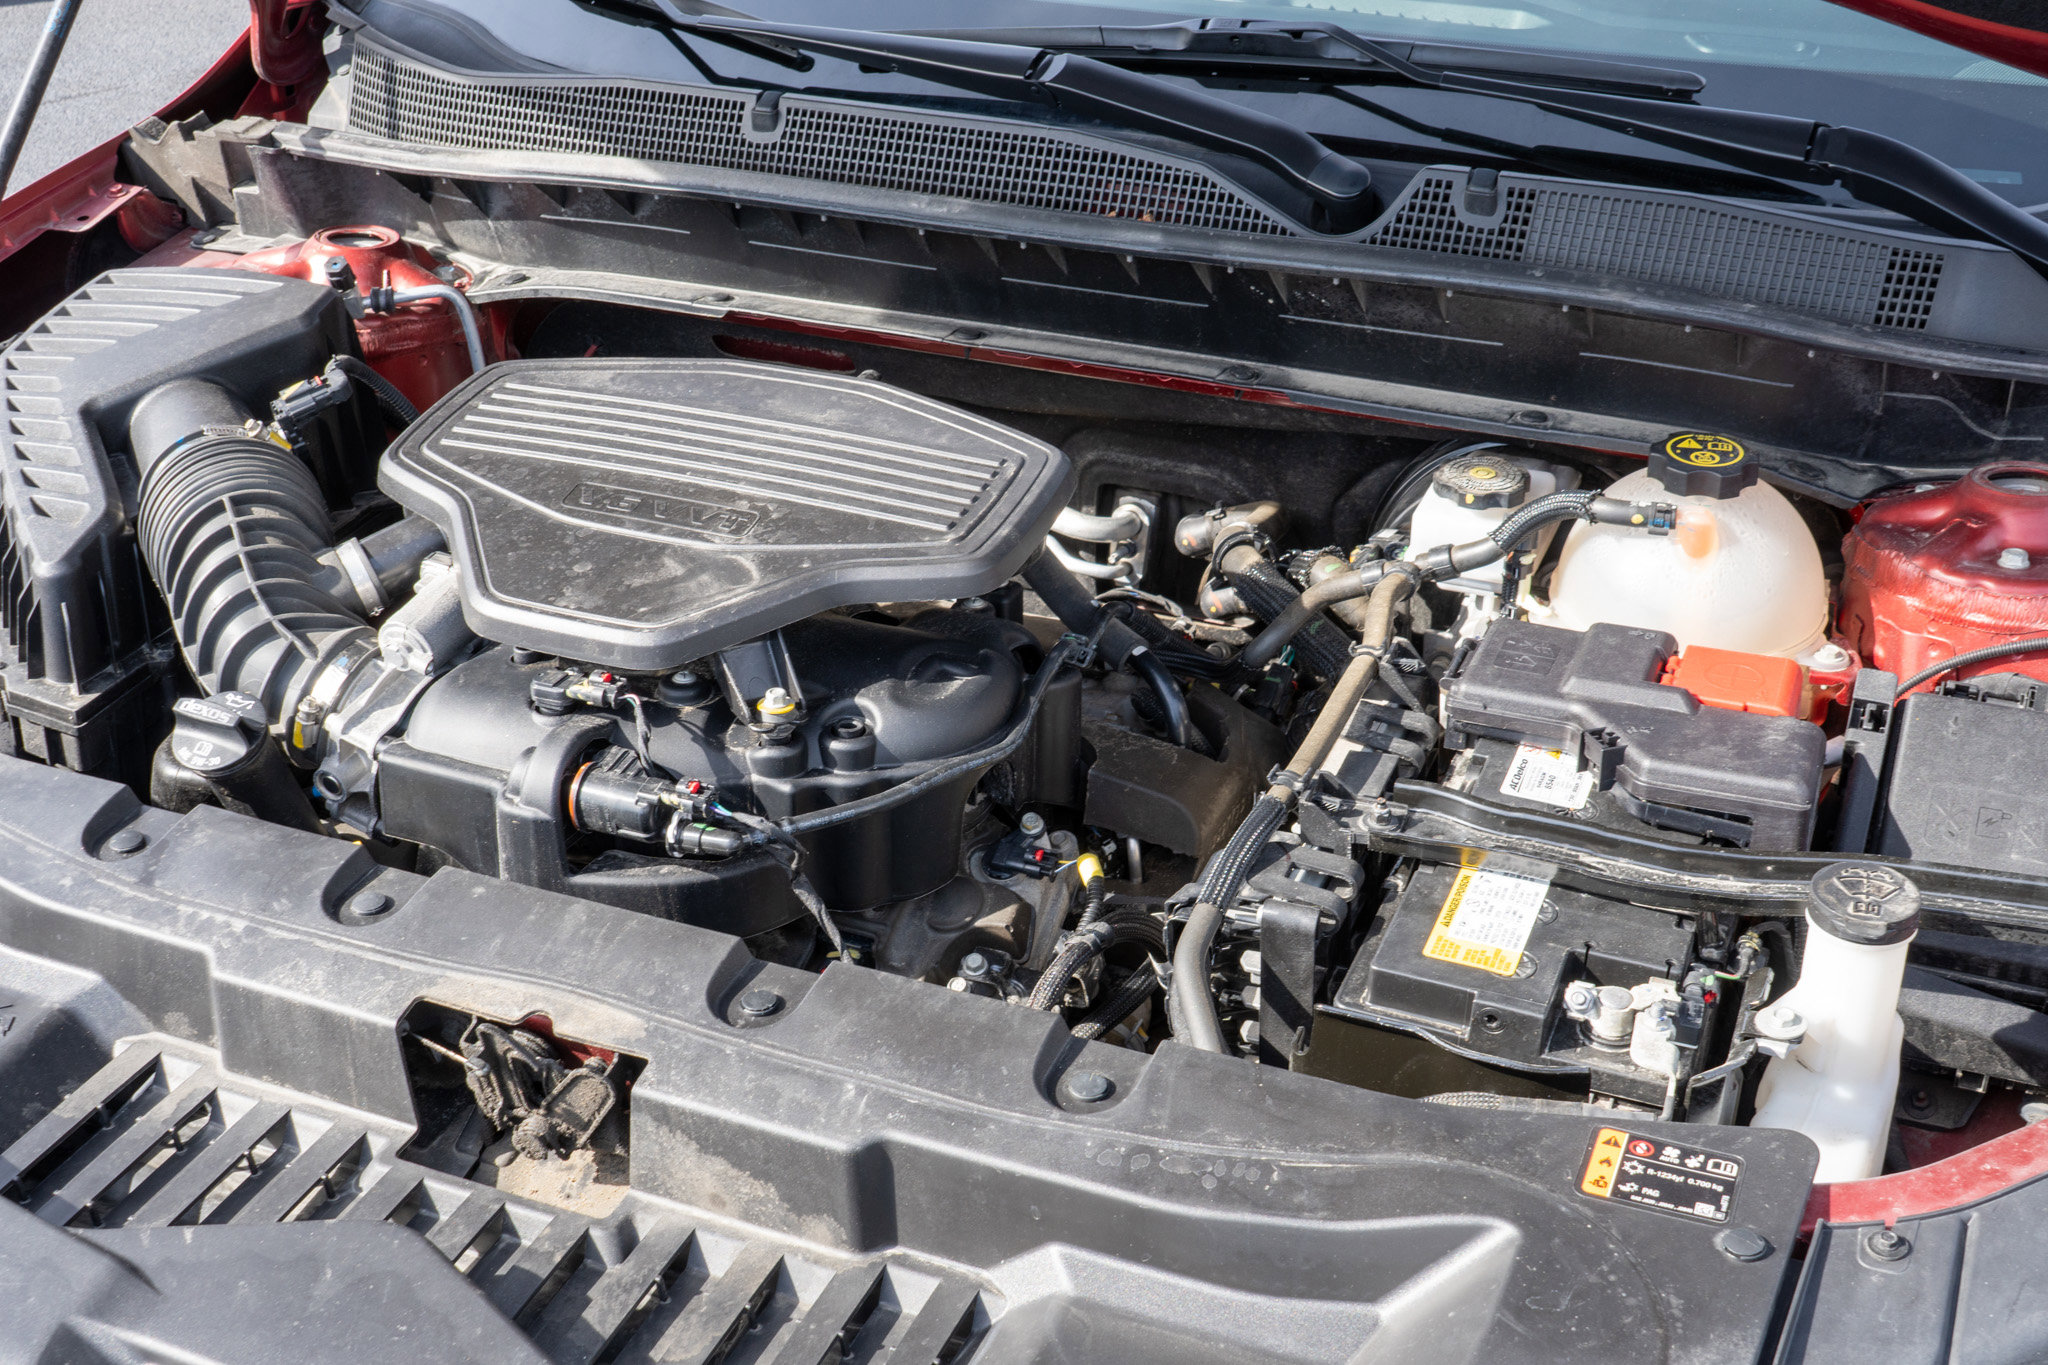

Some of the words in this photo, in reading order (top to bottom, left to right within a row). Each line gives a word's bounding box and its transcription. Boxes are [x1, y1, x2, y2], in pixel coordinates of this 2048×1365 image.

[179, 700, 233, 723] dexos
[1509, 758, 1529, 791] ACDelco
[1659, 1155, 1680, 1164] AUTO
[1646, 1168, 1684, 1182] R-1234yf
[1687, 1178, 1712, 1189] 0.700
[1712, 1183, 1724, 1192] kg
[1641, 1187, 1660, 1198] PAG
